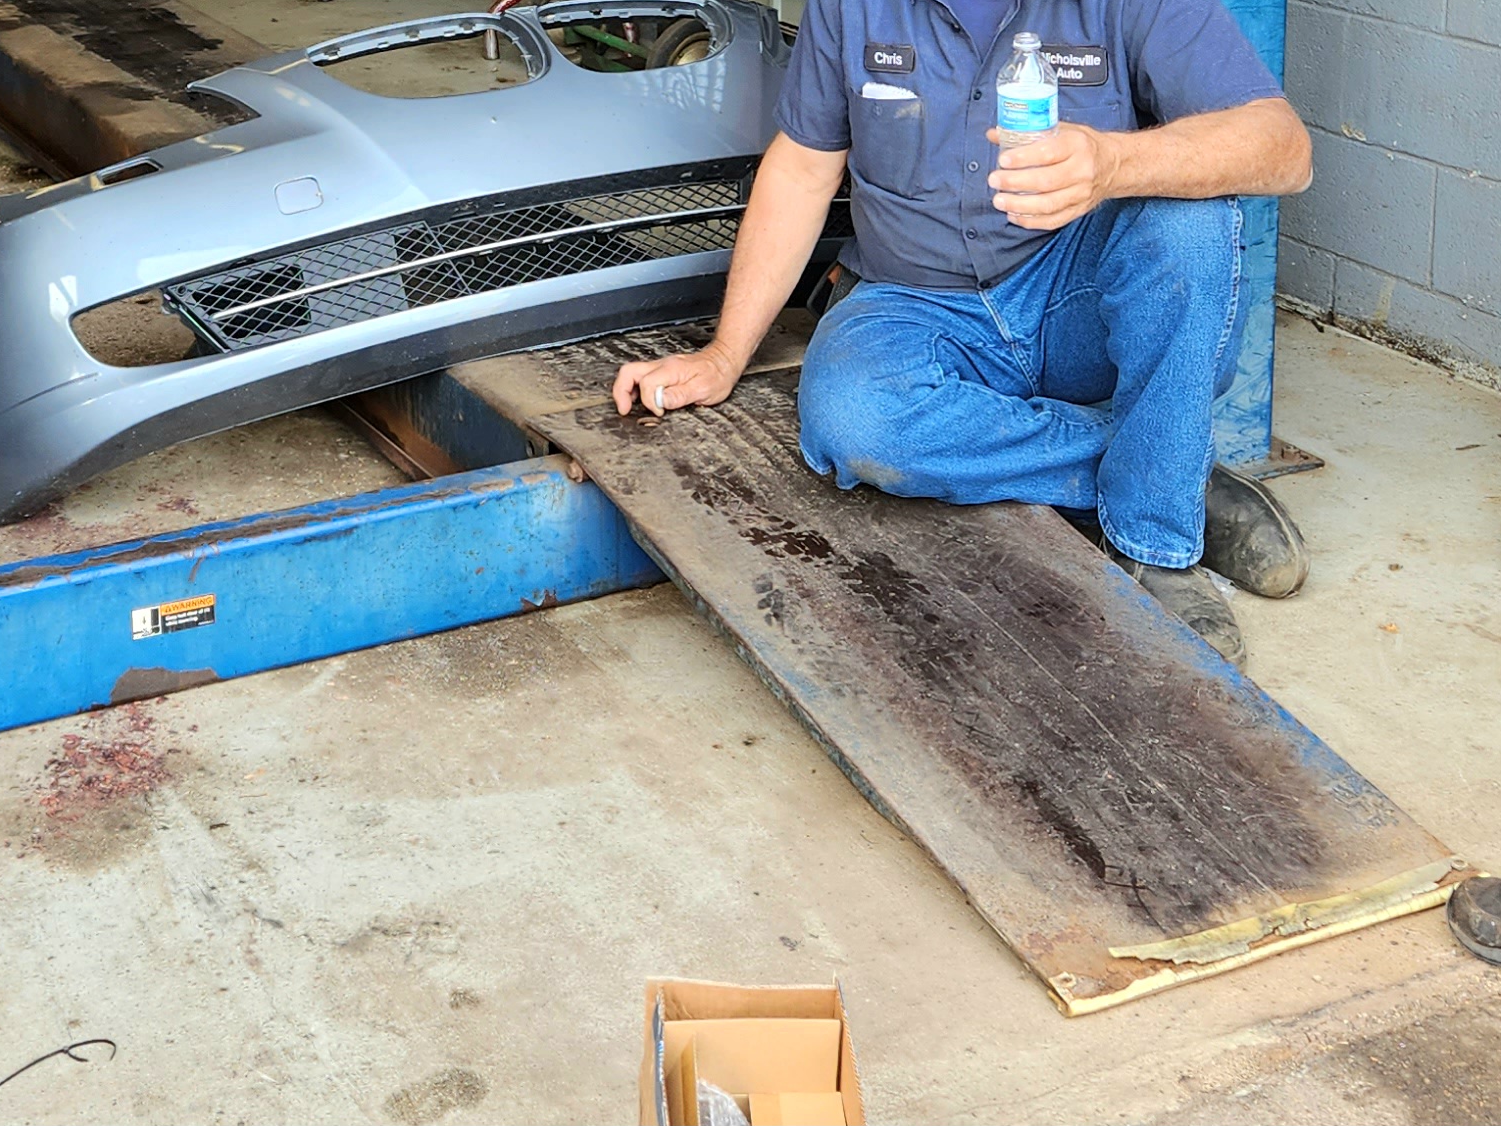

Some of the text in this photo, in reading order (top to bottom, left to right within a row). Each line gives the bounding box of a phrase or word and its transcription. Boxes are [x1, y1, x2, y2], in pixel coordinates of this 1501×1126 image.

[874, 51, 903, 66] Chris
[1056, 67, 1083, 80] Auto
[172, 596, 213, 611] WARNING
